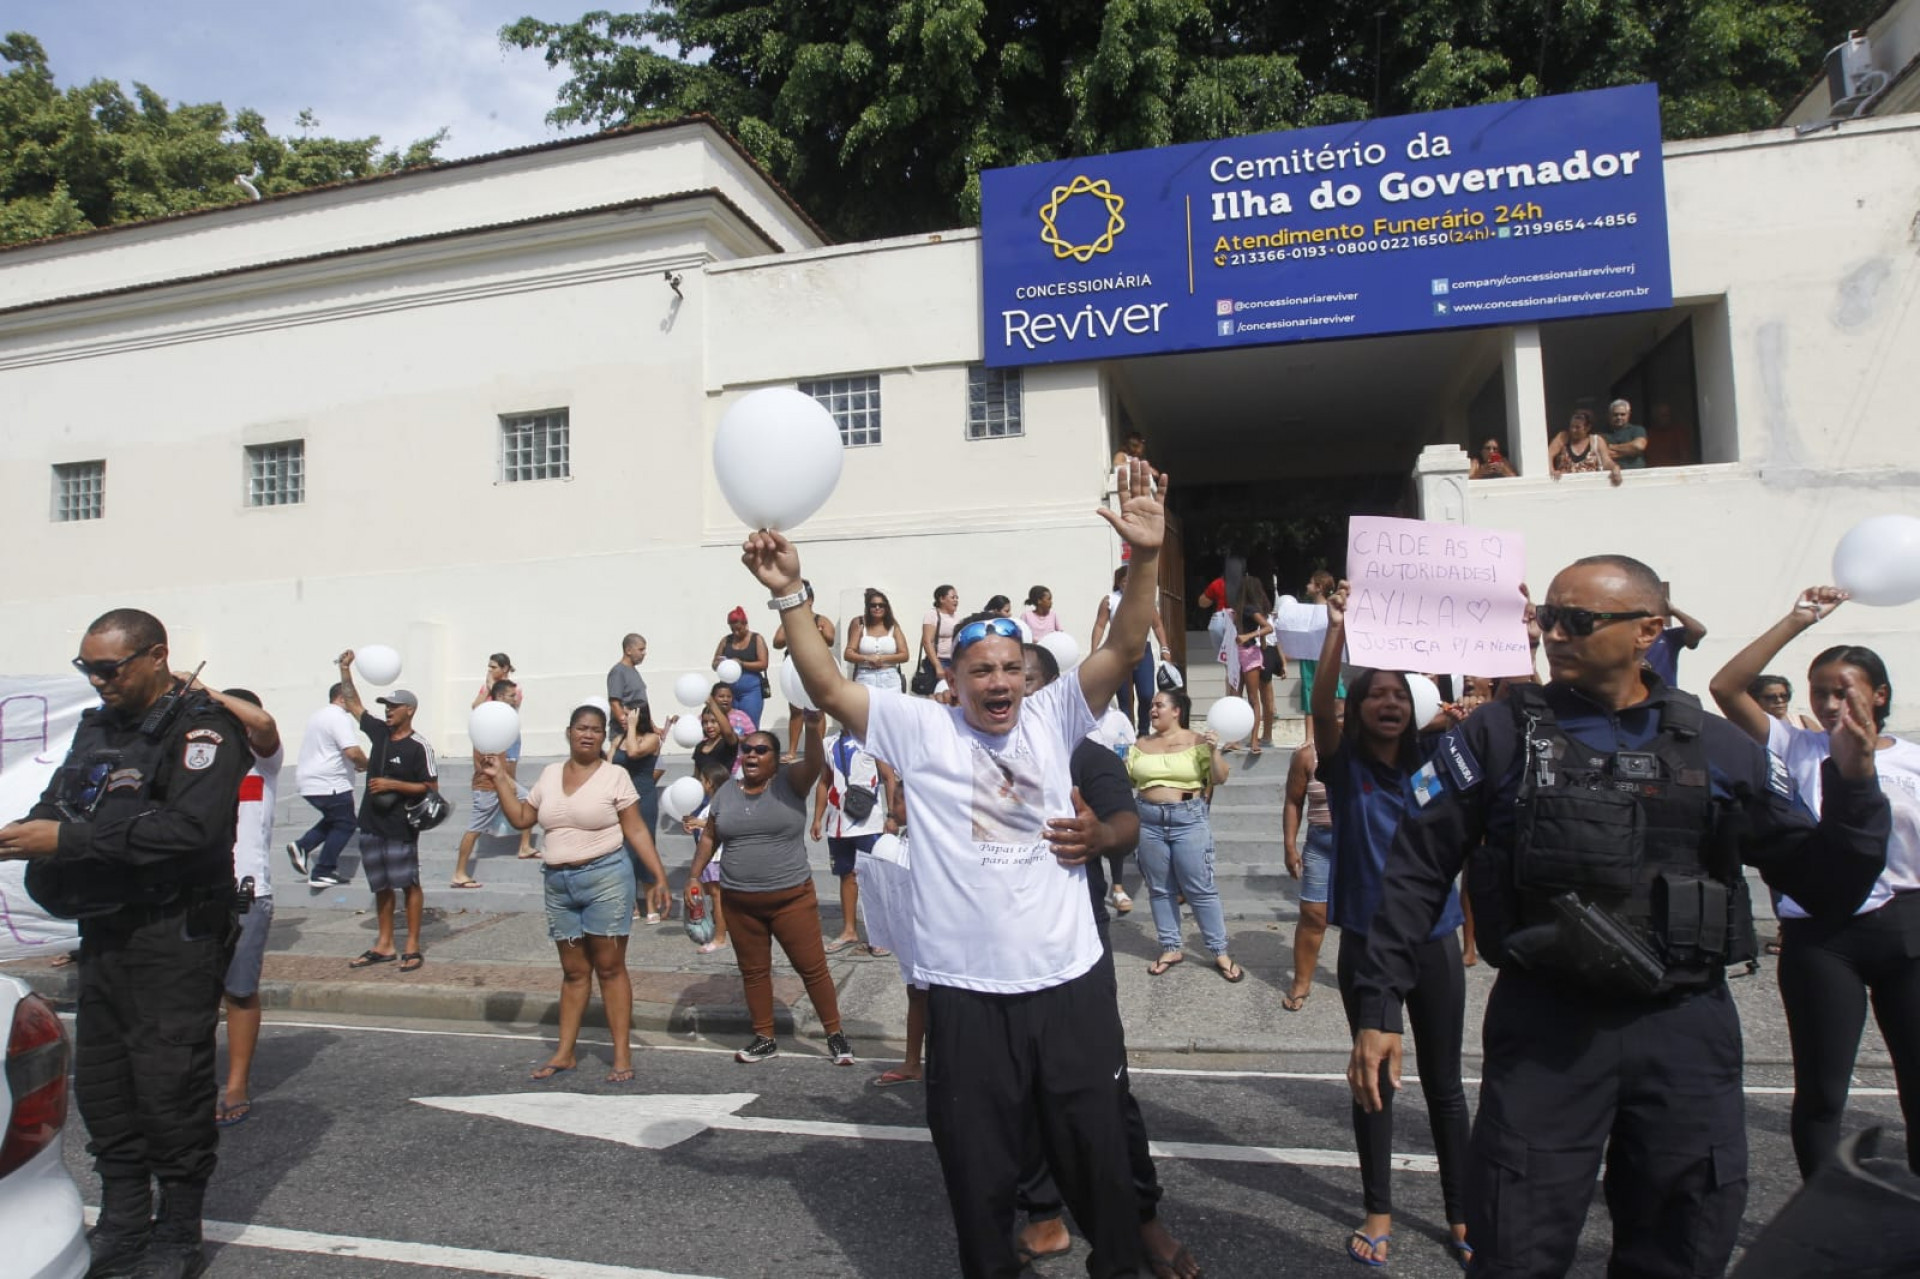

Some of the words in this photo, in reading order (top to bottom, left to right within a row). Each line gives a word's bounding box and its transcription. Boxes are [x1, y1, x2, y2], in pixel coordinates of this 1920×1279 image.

[1210, 141, 1386, 182] Cemitério
[1407, 131, 1452, 159] da
[1211, 189, 1293, 221] Ilha
[1309, 180, 1362, 210] do
[1379, 149, 1641, 201] Governador
[1214, 224, 1365, 253] Atendimento
[1374, 208, 1485, 236] Funerário
[1495, 201, 1543, 223] 24h
[1016, 271, 1152, 300] CONCESSIONÁRIA
[1234, 292, 1359, 312] @concessionariareviver
[1453, 285, 1651, 313] www.concessionariareviver.com.br
[1002, 302, 1169, 349] Reviver
[1352, 530, 1431, 556] CADE
[1444, 538, 1468, 559] AS
[1352, 588, 1455, 628] AYLLA
